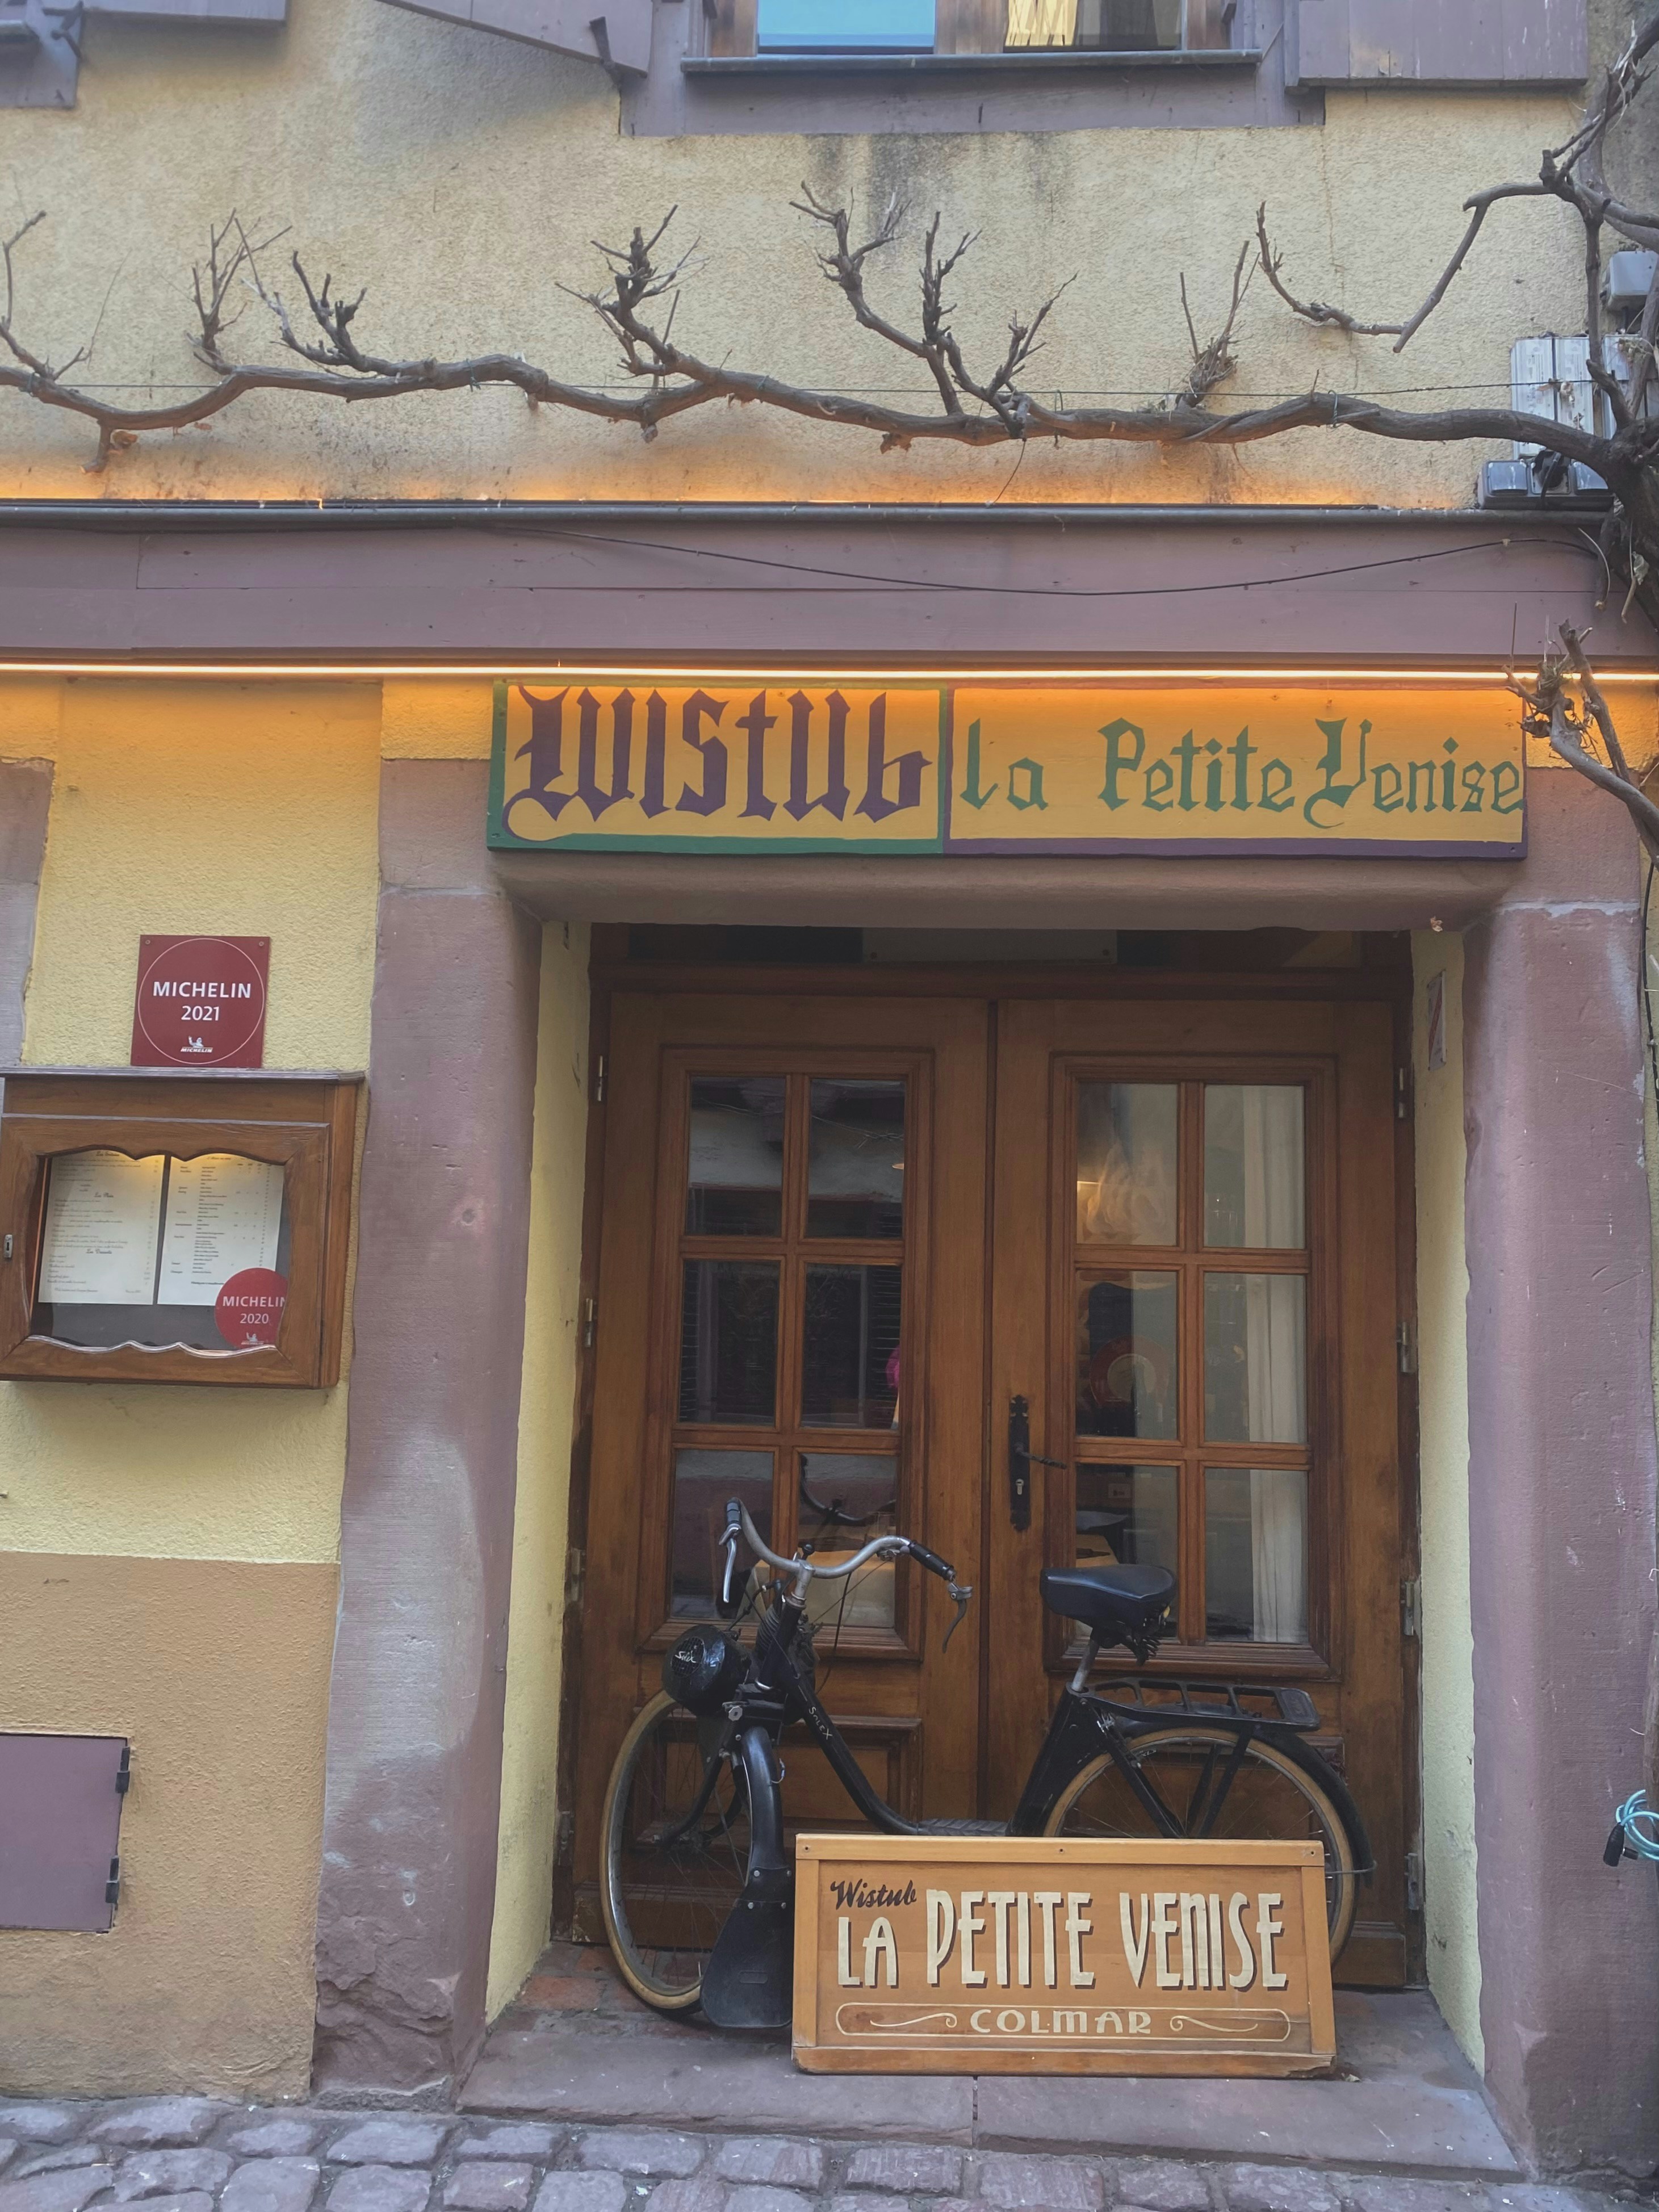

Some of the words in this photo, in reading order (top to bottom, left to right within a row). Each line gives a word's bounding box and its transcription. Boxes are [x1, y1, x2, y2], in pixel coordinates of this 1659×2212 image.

[960, 717, 1049, 810] La
[1097, 717, 1295, 812] Petite
[1304, 718, 1523, 828] Venise
[153, 981, 251, 998] MICHELIN
[181, 1006, 220, 1021] 2021
[240, 1313, 269, 1323] 2020
[830, 1879, 917, 1910] Wistub
[838, 1917, 898, 1987] LA
[926, 1889, 1095, 1988] PETITE
[1120, 1892, 1288, 1990] VENISE
[970, 2009, 1151, 2034] COLMAR
